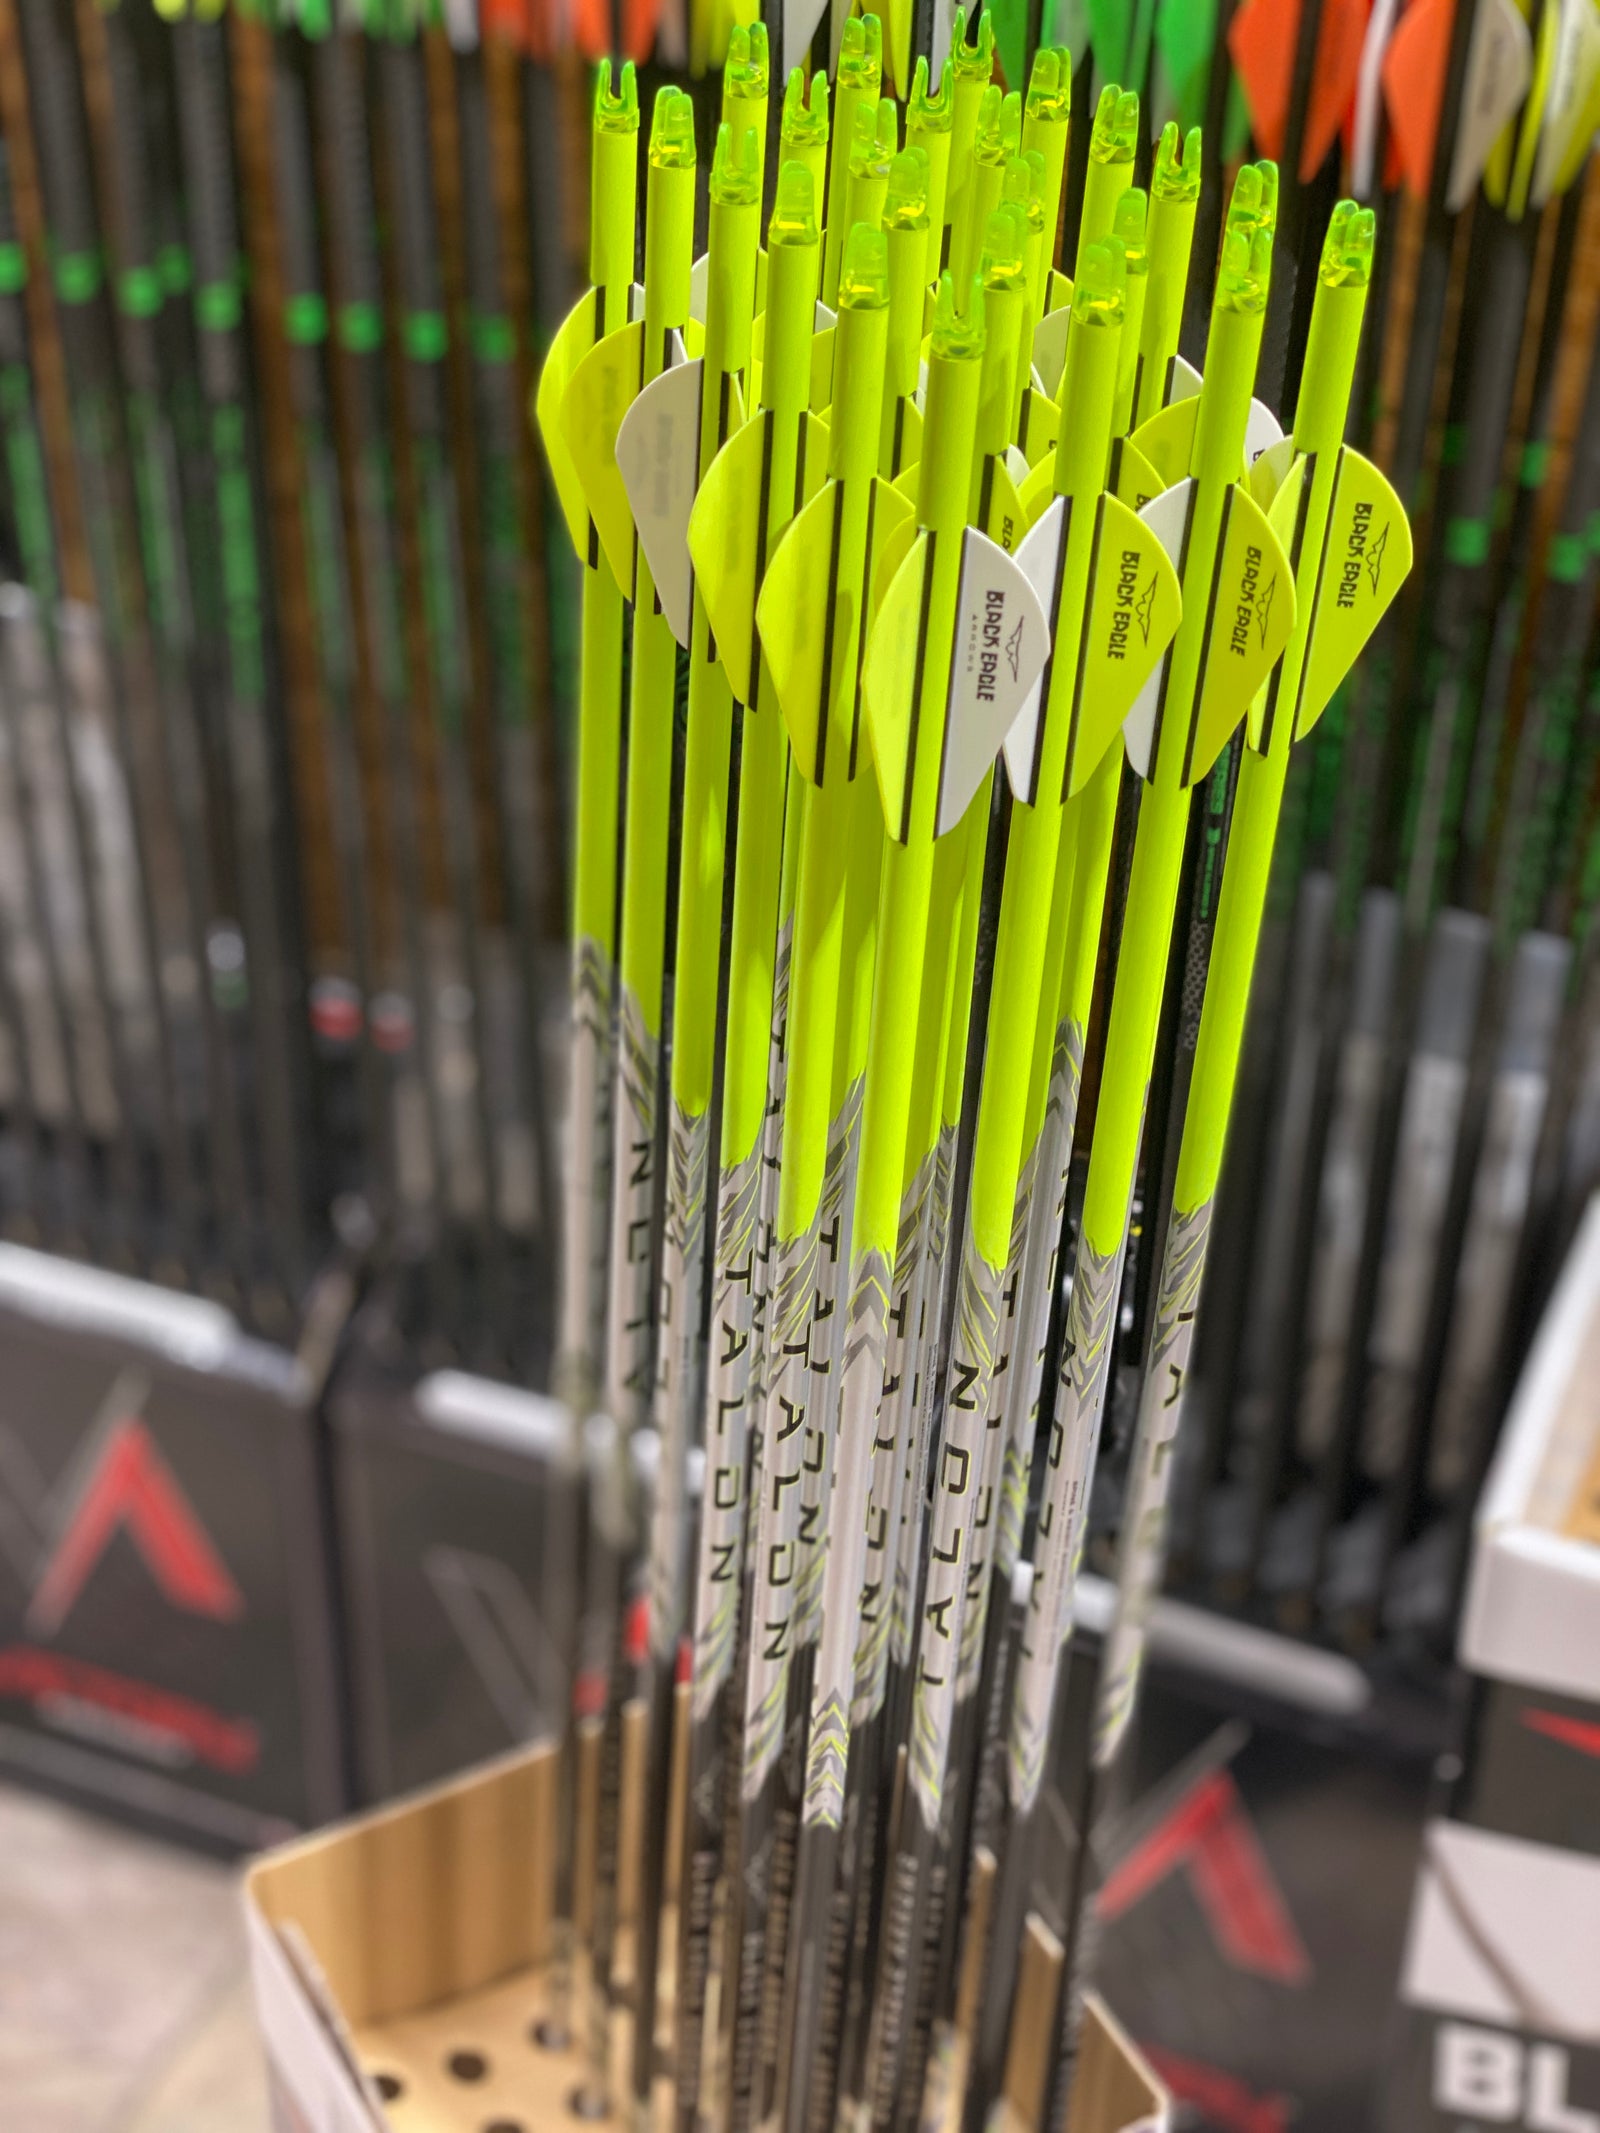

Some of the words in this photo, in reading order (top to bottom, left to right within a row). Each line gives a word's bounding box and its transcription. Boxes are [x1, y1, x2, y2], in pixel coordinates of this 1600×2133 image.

[1002, 515, 1014, 551] BLA
[1347, 502, 1373, 558] BLACK
[1115, 550, 1141, 607] BLACK
[1240, 545, 1262, 603] BLACK
[1336, 561, 1361, 609] EAGLE
[982, 590, 1005, 648] BLACK
[1107, 611, 1131, 660] EAGLE
[1230, 604, 1252, 657] EAGLE
[976, 652, 998, 702] EAGLE
[710, 1246, 755, 1583] TALON
[762, 1320, 812, 1661] TALON
[920, 1357, 981, 1687] TALON
